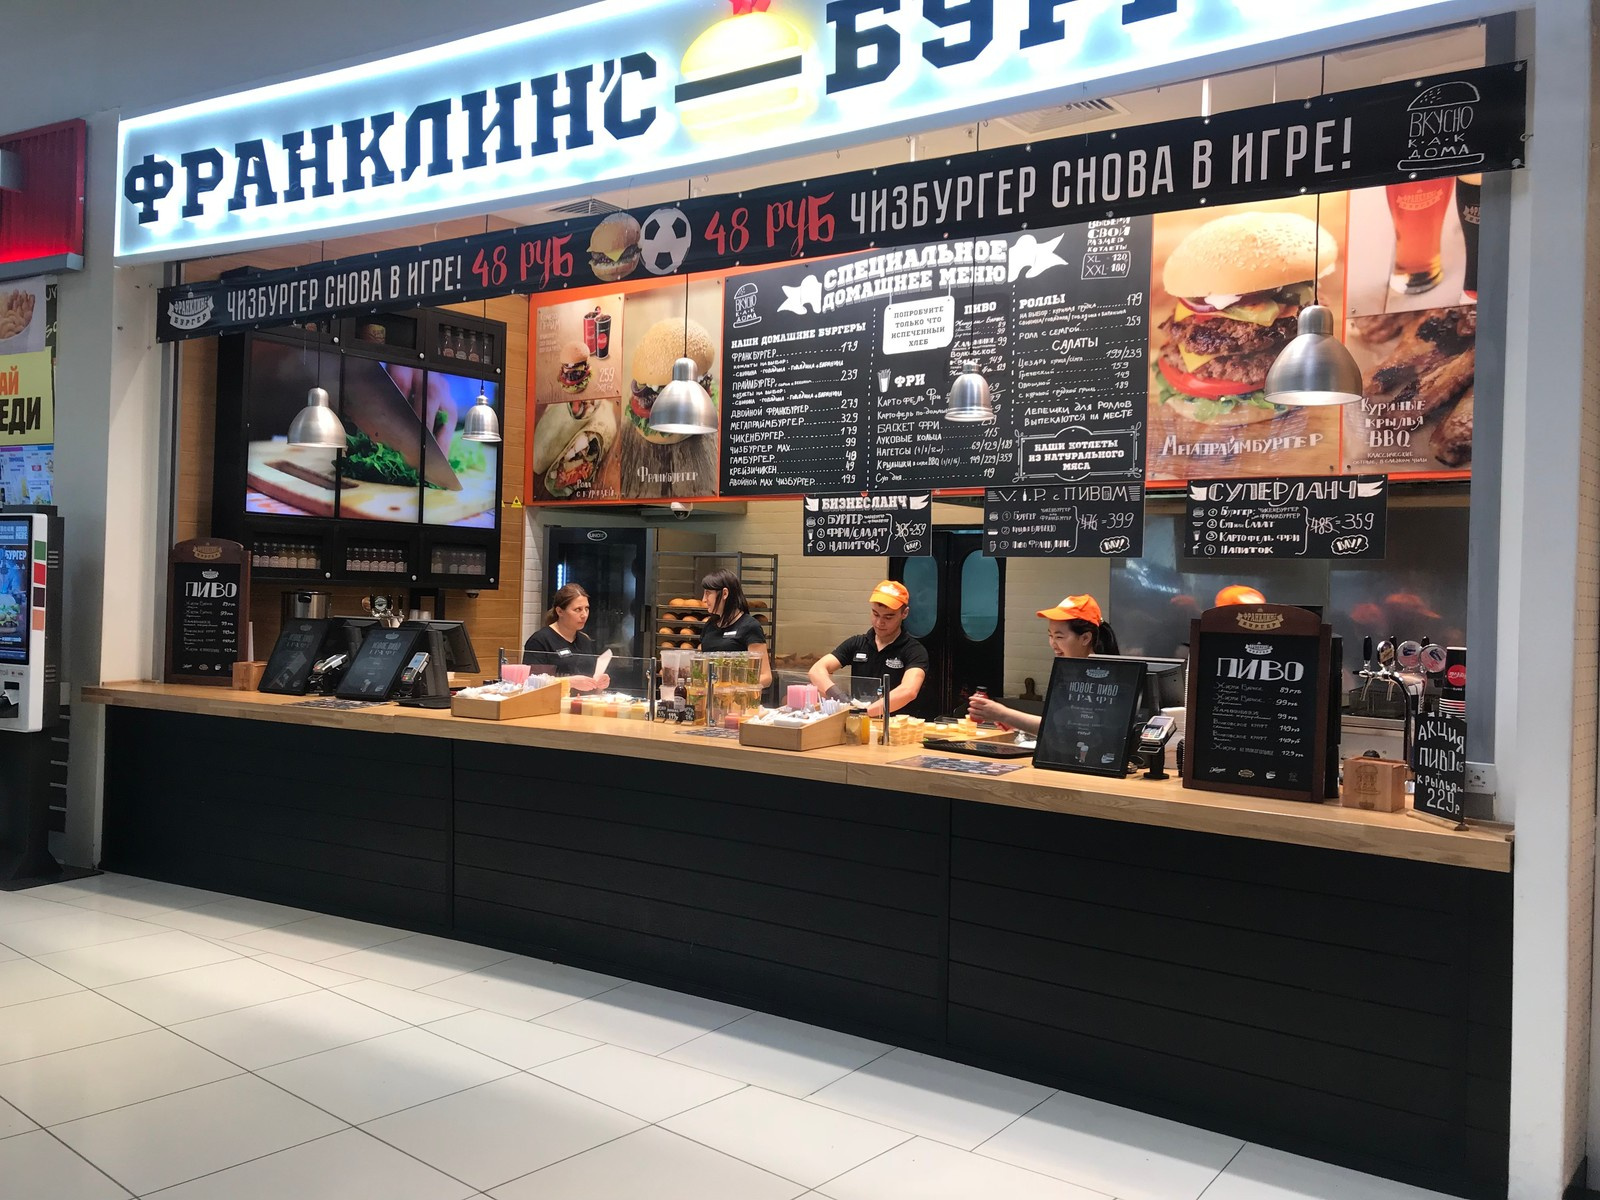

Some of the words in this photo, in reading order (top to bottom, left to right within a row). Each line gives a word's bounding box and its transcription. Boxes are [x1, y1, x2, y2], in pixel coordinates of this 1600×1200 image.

[1409, 105, 1474, 138] ВКУСНО
[1408, 144, 1469, 160] ДОМА
[227, 278, 318, 322] ЧИЗБУРГЕР
[325, 269, 383, 309] СНОВА
[390, 265, 401, 299] В
[407, 254, 462, 296] ИГРЕ!
[471, 244, 507, 288] 48
[704, 207, 750, 256] 48
[850, 166, 1036, 235] ЧИЗБУРГЕР
[1052, 144, 1174, 208] СНОВА
[1192, 139, 1213, 190] В
[1231, 116, 1352, 185] ИГРЕ!
[1087, 225, 1131, 239] СВОЙ
[824, 239, 1007, 290] СПЕЦИАЛЬНОЕ
[1087, 255, 1102, 264] XL
[1084, 264, 1108, 278] XXL
[822, 271, 933, 312] ДОМАШНЕЕ
[938, 264, 1007, 290] МЕНЮ
[1019, 293, 1066, 310] РОЛЛЫ
[1126, 292, 1143, 306] 179
[964, 301, 997, 316] ПИВО
[736, 313, 758, 323] ДОМА
[895, 318, 925, 329] ТОЛЬКО
[926, 316, 942, 325] ЧТО
[1125, 315, 1141, 327] 259
[731, 339, 759, 349] НАШИ
[760, 330, 816, 346] ДОМАШНИЕ
[818, 322, 867, 338] БУРГЕРЫ
[908, 338, 929, 347] ХЛЕБ
[840, 340, 859, 353] 179
[1052, 336, 1099, 355] САЛАТЫ
[840, 369, 859, 382] 239
[894, 373, 926, 388] ФРИ
[840, 398, 859, 410] 279
[1097, 400, 1133, 411] РОЛЛОВ
[841, 412, 859, 424] 329
[1024, 413, 1086, 427] ВЫПЕКАЮТСЯ
[1103, 409, 1134, 421] МЕСТЕ
[877, 421, 915, 434] БАСКЕТ
[918, 420, 940, 431] ФРИ
[730, 430, 785, 444] ЧИКЕНБУРГЕР
[840, 425, 858, 436] 179
[876, 433, 913, 446] ЛУКОВЫЕ
[1369, 429, 1412, 448] BBQ
[730, 444, 774, 455] ЧИЗБУРГЕР
[845, 437, 857, 447] 99
[876, 446, 912, 457] НАГЕТСЫ
[1034, 443, 1066, 453] НАШИ
[1068, 439, 1119, 451] КОТЛЕТЫ
[730, 454, 775, 465] ГАМБУРГЕР
[845, 450, 858, 461] 48
[1028, 454, 1042, 463] ИЗ
[1043, 450, 1125, 462] НАТУРАЛЬНОГО
[1062, 462, 1091, 471] МЯСА
[1063, 485, 1129, 502] ПИВОМ
[1208, 480, 1358, 509] СУПЕРЛАНЧ
[827, 513, 864, 526] БУРГЕР
[827, 527, 888, 540] ФРИ/САЛАТ
[828, 539, 882, 552] НАПИТОК
[185, 581, 238, 599] ПИВО
[1216, 657, 1305, 683] ПИВО
[1096, 683, 1120, 697] ПИВО
[1418, 720, 1465, 755] АКЦИЯ
[1418, 746, 1456, 772] ПИВО
[1417, 774, 1457, 794] КРЫЛЬЯ
